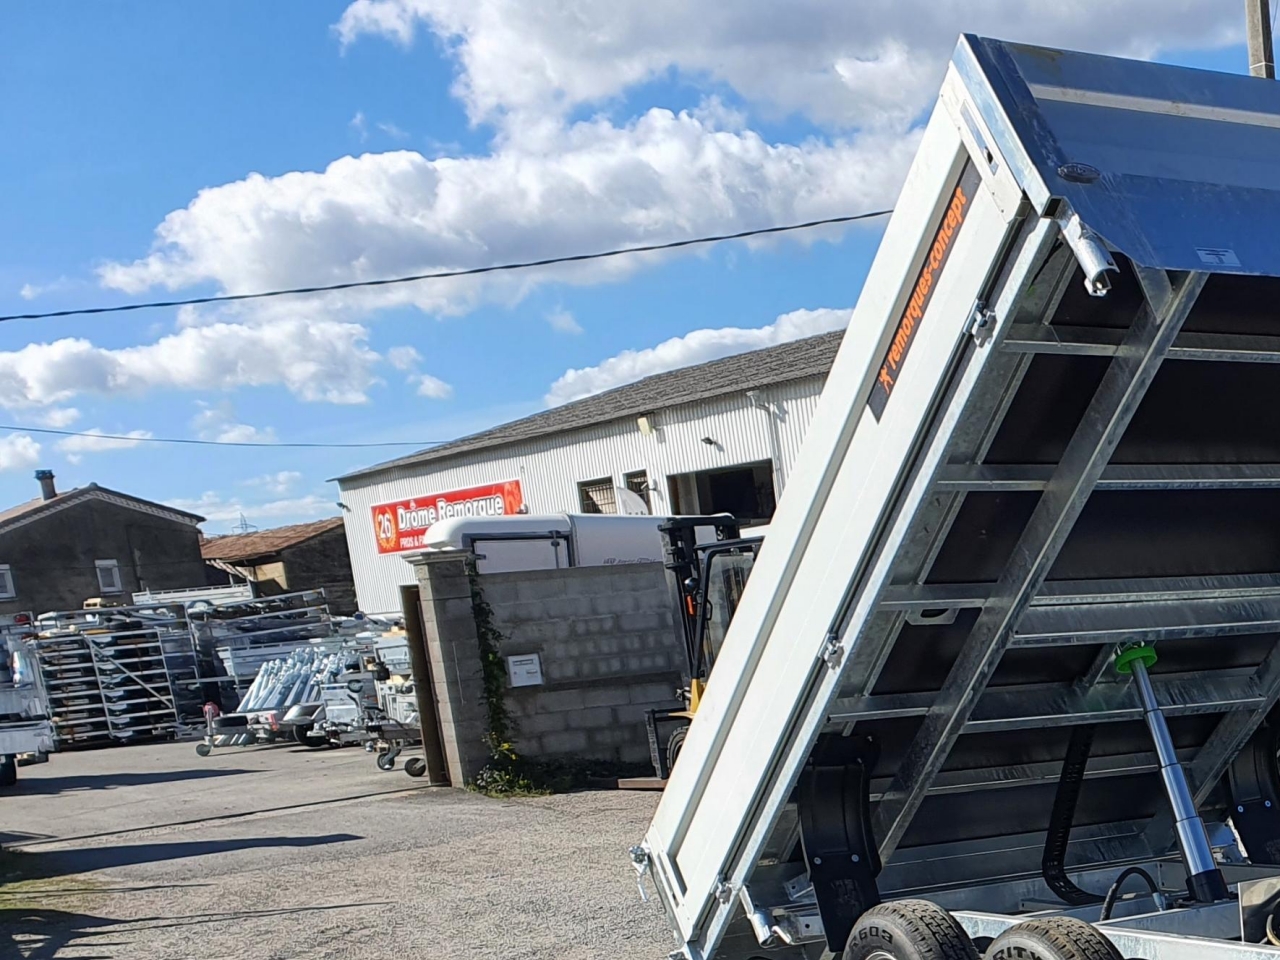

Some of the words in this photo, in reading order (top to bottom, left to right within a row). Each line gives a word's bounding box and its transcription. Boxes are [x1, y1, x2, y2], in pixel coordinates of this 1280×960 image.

[886, 186, 967, 371] remorques-concept
[378, 513, 392, 539] 26
[397, 500, 437, 530] Drôme
[437, 494, 504, 519] Remorque
